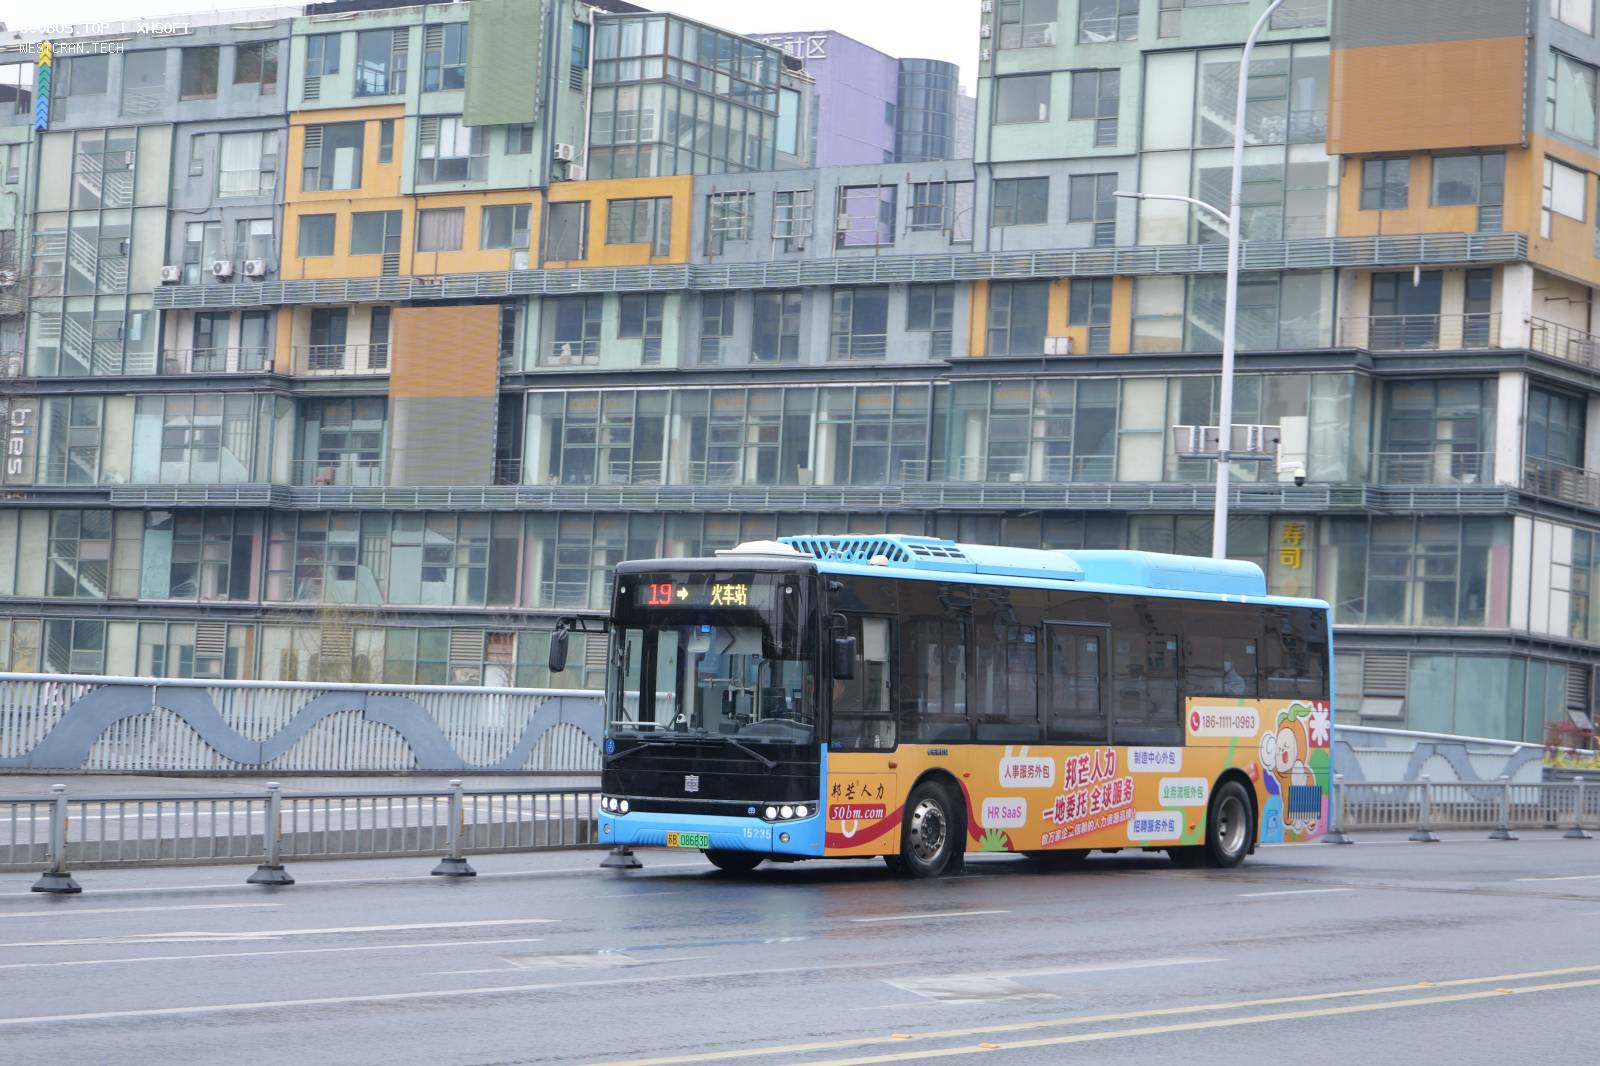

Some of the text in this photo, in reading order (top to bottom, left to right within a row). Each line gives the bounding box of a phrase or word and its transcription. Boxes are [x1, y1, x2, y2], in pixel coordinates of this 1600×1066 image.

[1279, 522, 1303, 570] 寿司
[648, 583, 748, 606] 19 火车站
[1202, 715, 1256, 729] 186-1111-0963
[1134, 751, 1176, 765] 制造中心外包
[1003, 764, 1050, 779] 人事服务外包
[1065, 748, 1116, 788] 邦芒人力
[831, 782, 886, 801] 邦芒人力
[1163, 785, 1205, 799] 业务流程外包
[1043, 778, 1134, 822] 一地委托 全球服务
[831, 804, 885, 820] 50bm.com
[987, 806, 1022, 819] HR SaaS
[1133, 818, 1175, 833] 招聘服务外包
[743, 827, 772, 840] 15235
